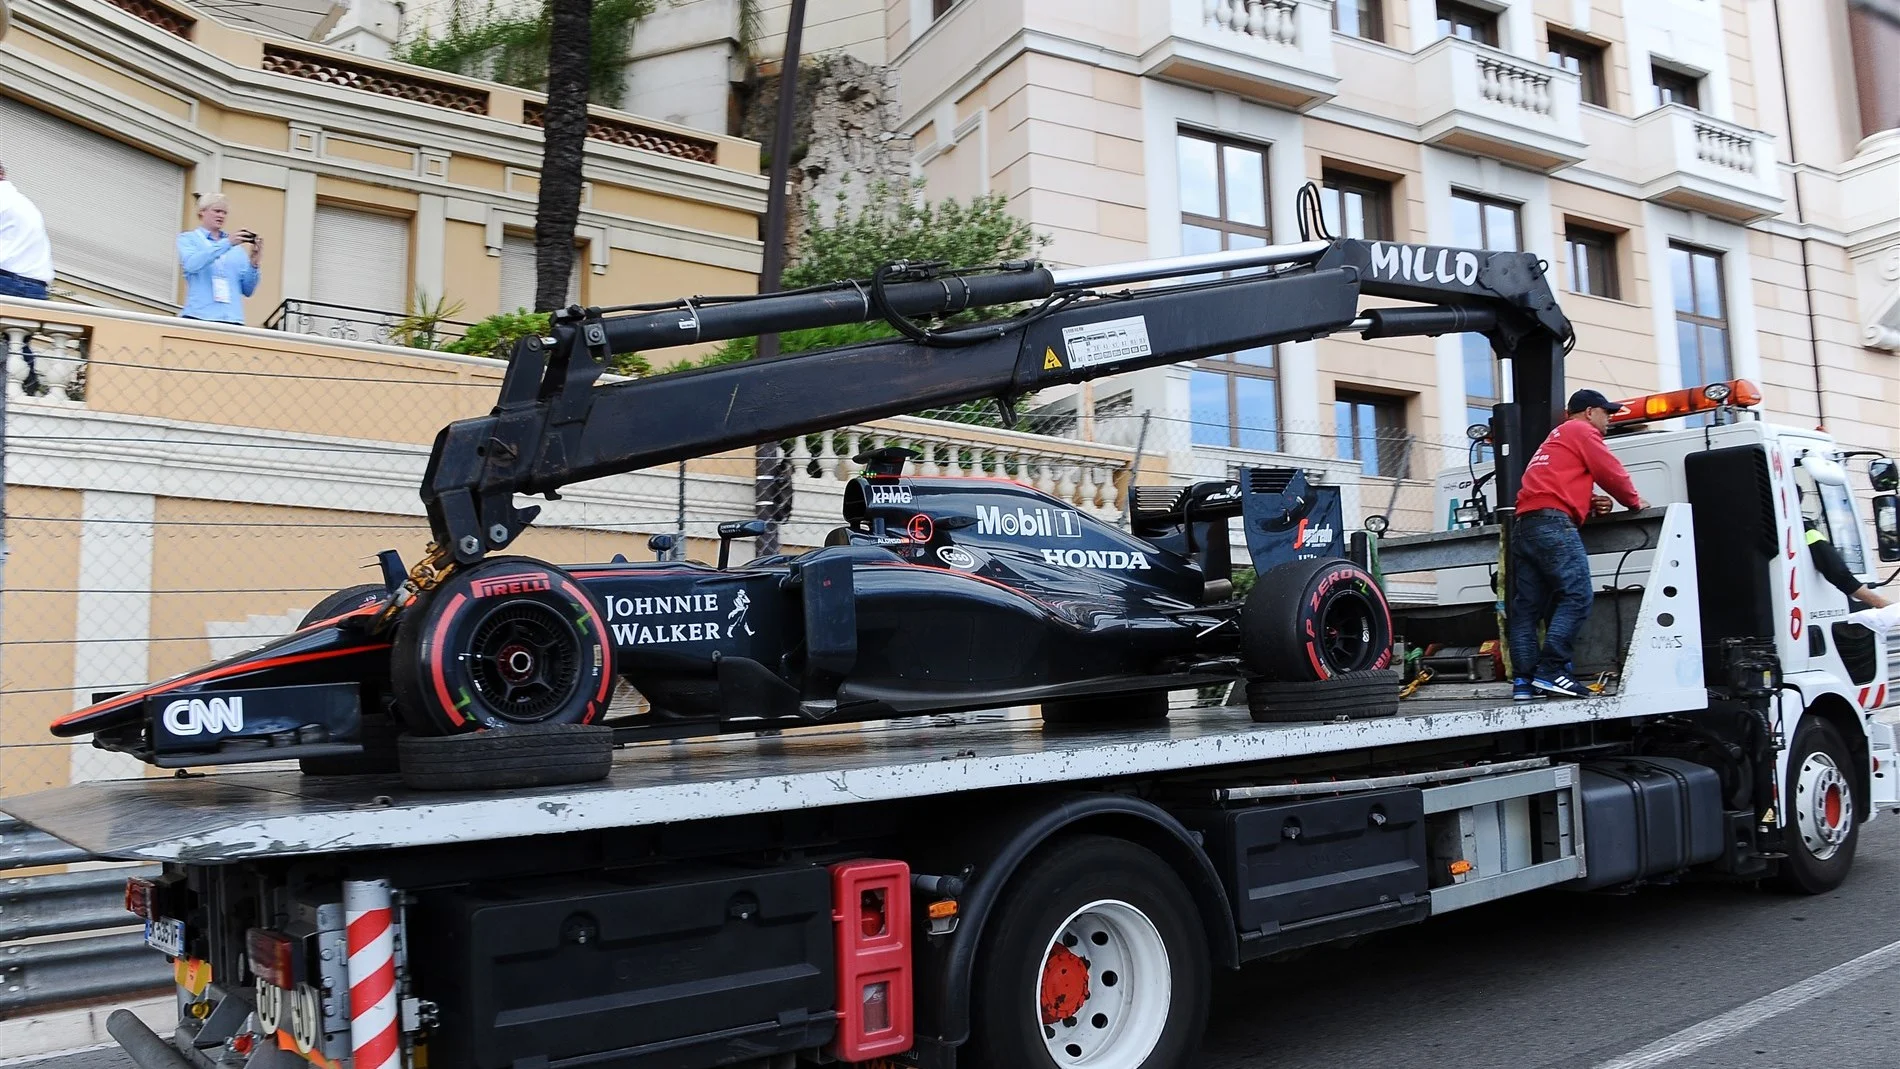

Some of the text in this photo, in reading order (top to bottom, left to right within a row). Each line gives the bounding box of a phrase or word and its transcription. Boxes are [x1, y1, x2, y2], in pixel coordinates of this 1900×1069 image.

[1371, 241, 1479, 286] MILLO
[872, 490, 912, 504] KPMG
[976, 505, 1051, 536] Mobil
[1770, 447, 1803, 641] MILLO
[1041, 549, 1151, 570] HONDA
[469, 572, 551, 599] PIRELLI
[1310, 569, 1353, 613] ZERO
[605, 593, 719, 622] JOHNNIE
[611, 622, 721, 646] WALKER
[163, 696, 244, 737] CNN
